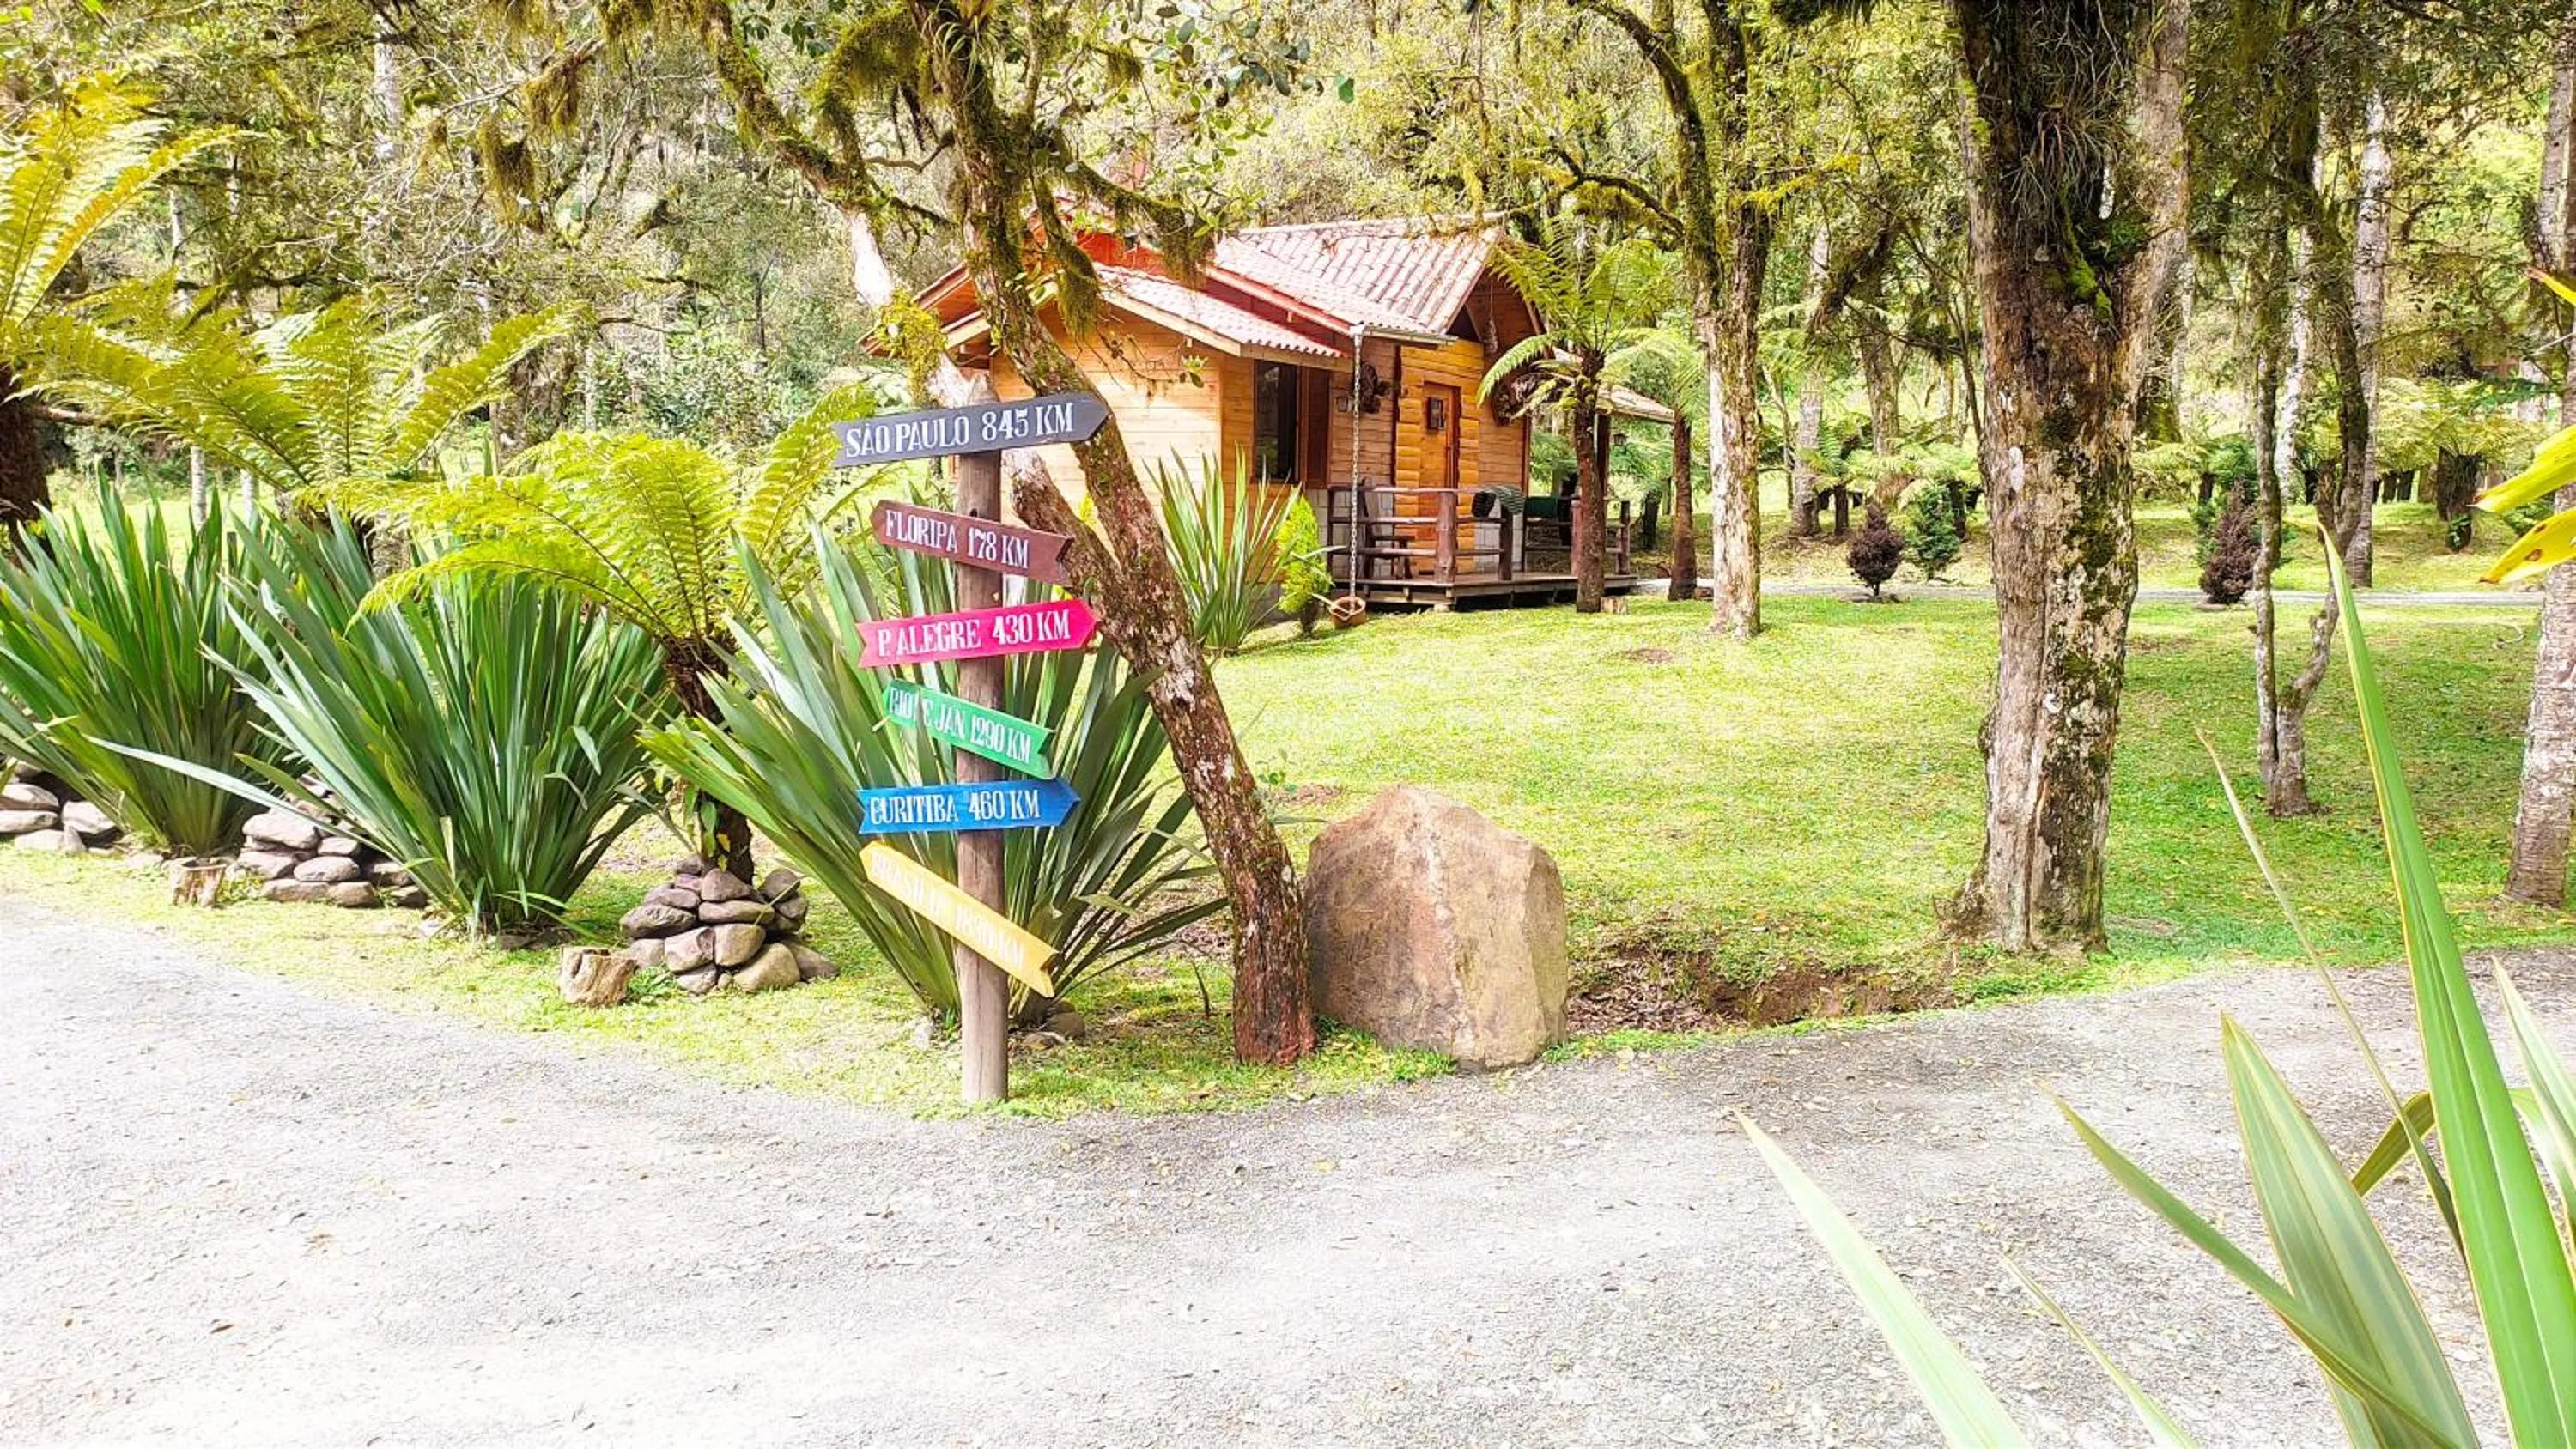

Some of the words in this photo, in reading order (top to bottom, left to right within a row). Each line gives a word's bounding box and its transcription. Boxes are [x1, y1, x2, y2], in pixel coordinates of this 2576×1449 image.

[896, 415, 969, 451] PAULO
[981, 409, 1029, 441] 845
[1036, 403, 1073, 434] KM
[885, 509, 957, 553] FLORIPA
[968, 527, 997, 560] 178
[1001, 535, 1029, 569] KM
[896, 620, 981, 656] ALEGRE
[992, 614, 1032, 645] 430
[1036, 609, 1071, 641] KM
[889, 687, 914, 719] RIO
[935, 702, 965, 740] JAN
[970, 714, 1005, 753] 1290
[1007, 727, 1030, 763] KM
[870, 794, 958, 825] CURITIBA
[969, 791, 1005, 821] 460
[1009, 790, 1041, 820] KM
